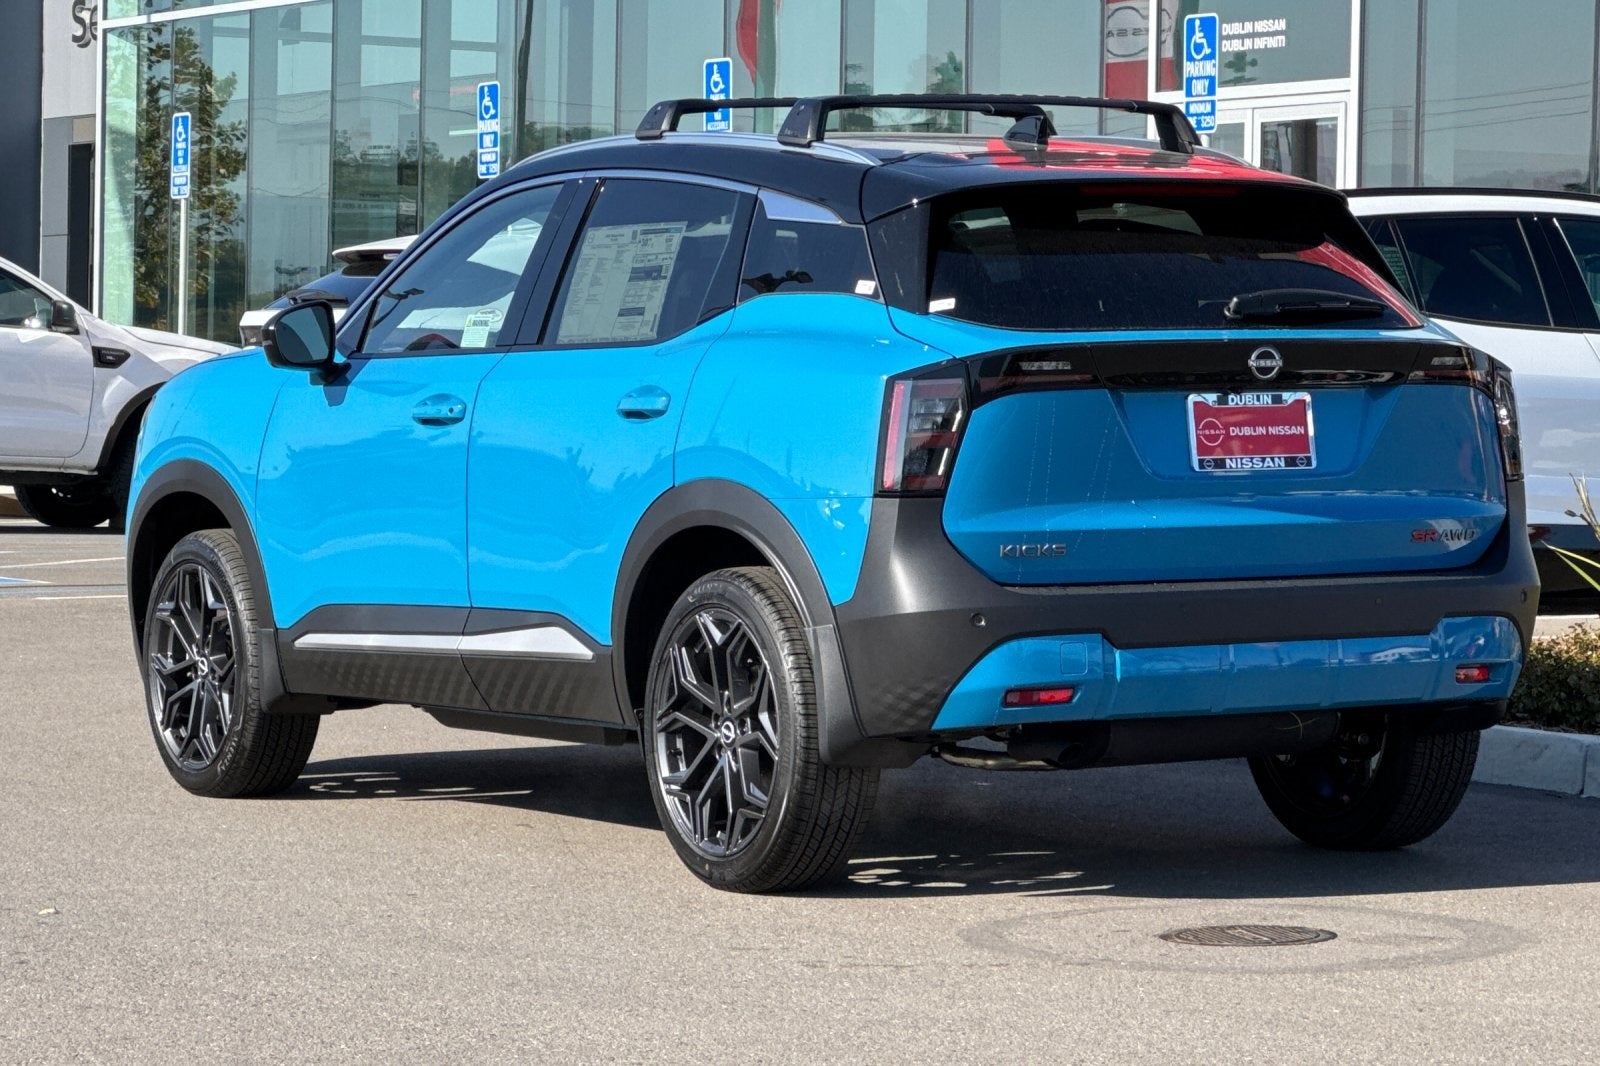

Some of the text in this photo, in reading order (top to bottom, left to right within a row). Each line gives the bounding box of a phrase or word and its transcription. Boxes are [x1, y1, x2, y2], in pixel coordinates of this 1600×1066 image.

[1222, 18, 1286, 35] DUBLIN NISSAN
[1222, 35, 1286, 52] DUBLIN INFINITI
[1186, 60, 1216, 77] PARKING
[1192, 79, 1209, 96] ONLY
[1189, 102, 1212, 114] MINIMUM
[479, 118, 498, 132] PARKING
[483, 133, 494, 148] ONLY
[1249, 359, 1282, 367] NISSAN
[1228, 394, 1272, 405] DUBLIN
[1229, 425, 1304, 436] DUBLIN NISSAN
[1226, 457, 1285, 469] NISSAN
[1440, 528, 1477, 542] AWD
[999, 543, 1066, 558] KICKS
